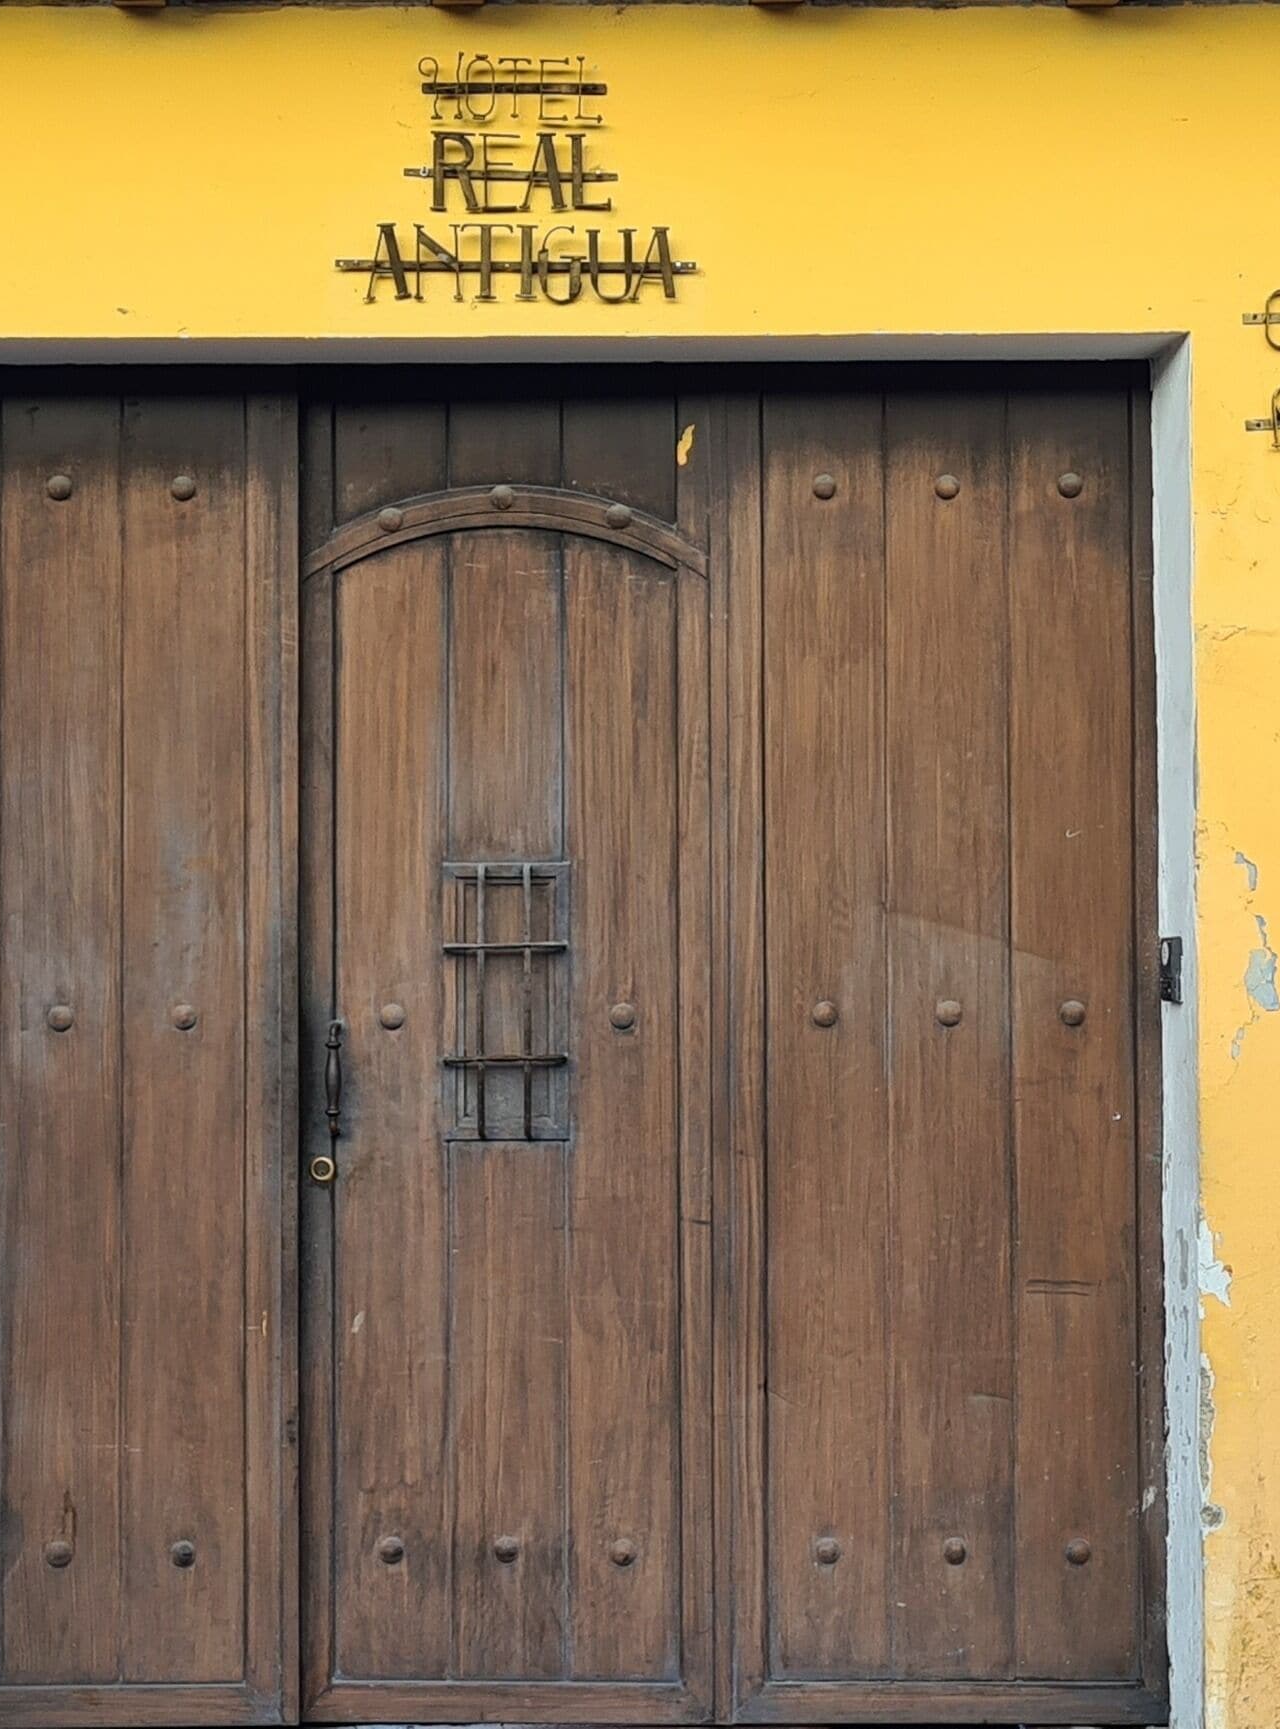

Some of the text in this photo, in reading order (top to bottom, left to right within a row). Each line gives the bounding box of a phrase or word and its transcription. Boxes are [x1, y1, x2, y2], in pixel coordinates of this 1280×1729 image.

[418, 51, 603, 123] HOTEL
[430, 130, 612, 212] REAL
[363, 223, 677, 304] ANTIGUA
